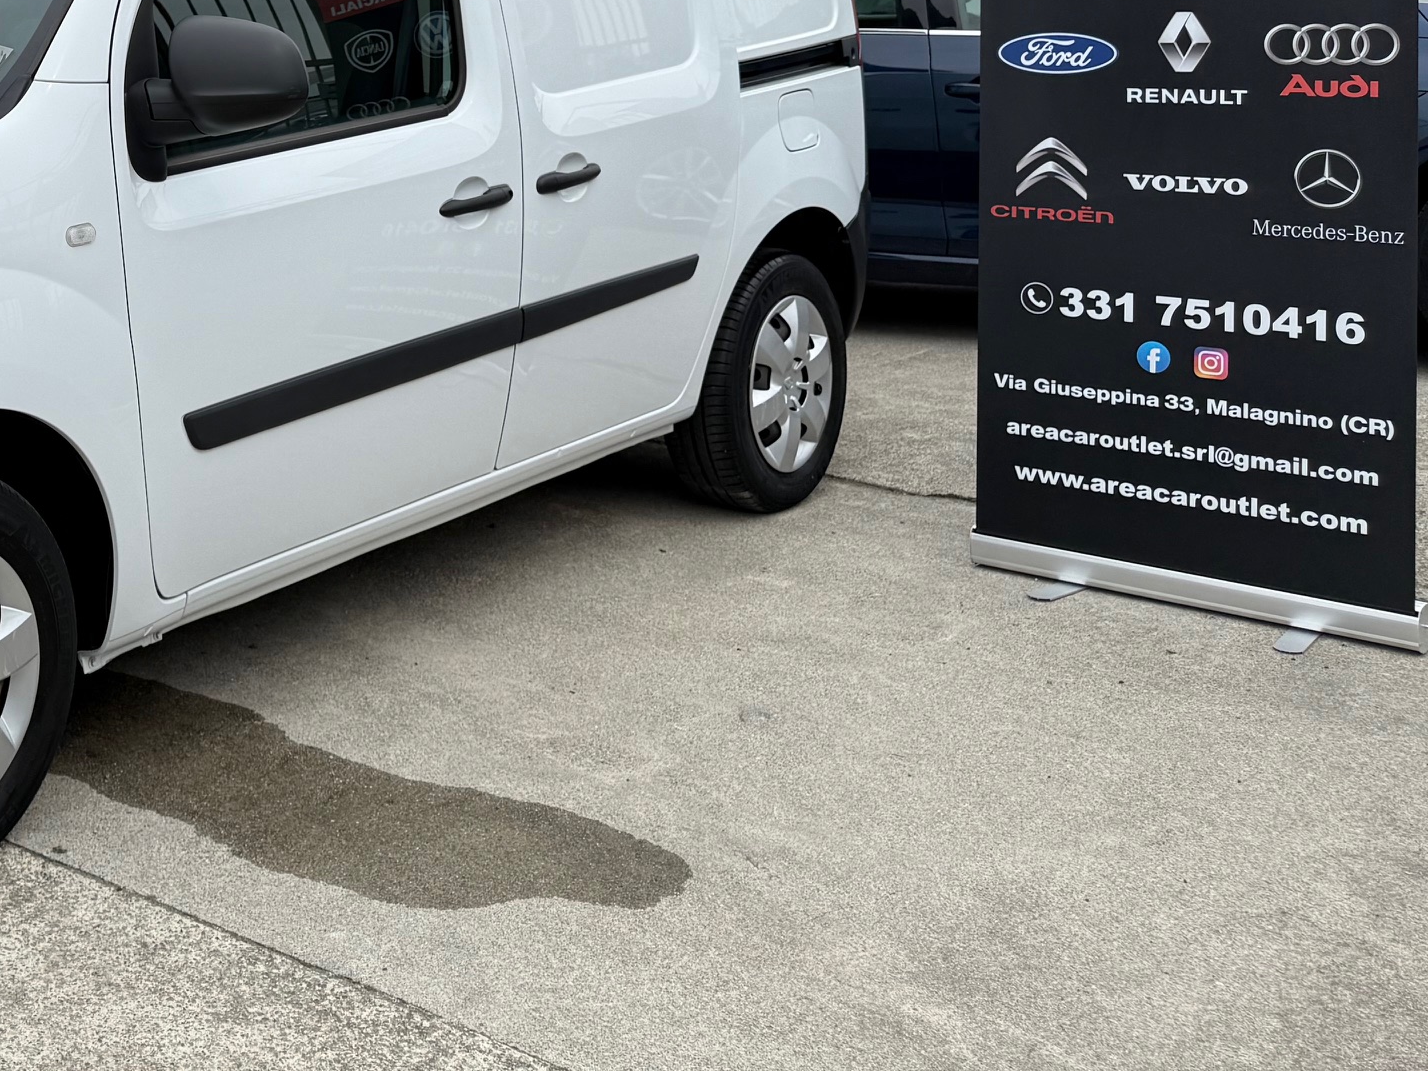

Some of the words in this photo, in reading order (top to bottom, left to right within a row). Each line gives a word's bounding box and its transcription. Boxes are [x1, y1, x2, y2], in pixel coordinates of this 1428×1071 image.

[1020, 39, 1093, 69] Ford
[1126, 87, 1249, 106] RENAULT
[1123, 173, 1249, 195] VOLVO
[1252, 219, 1405, 246] Mercedes-Benz
[1059, 287, 1135, 323] 331
[1155, 296, 1366, 345] 7510416
[994, 373, 1027, 391] Via
[1033, 378, 1160, 409] Giuseppina
[1164, 395, 1200, 415] 33,
[1206, 399, 1333, 430] Malagnino
[1340, 414, 1395, 440] (CR)
[1006, 420, 1380, 487] areacaroutlet.srl@gmail.com
[1015, 465, 1369, 535] www.areacaroutlet.com
